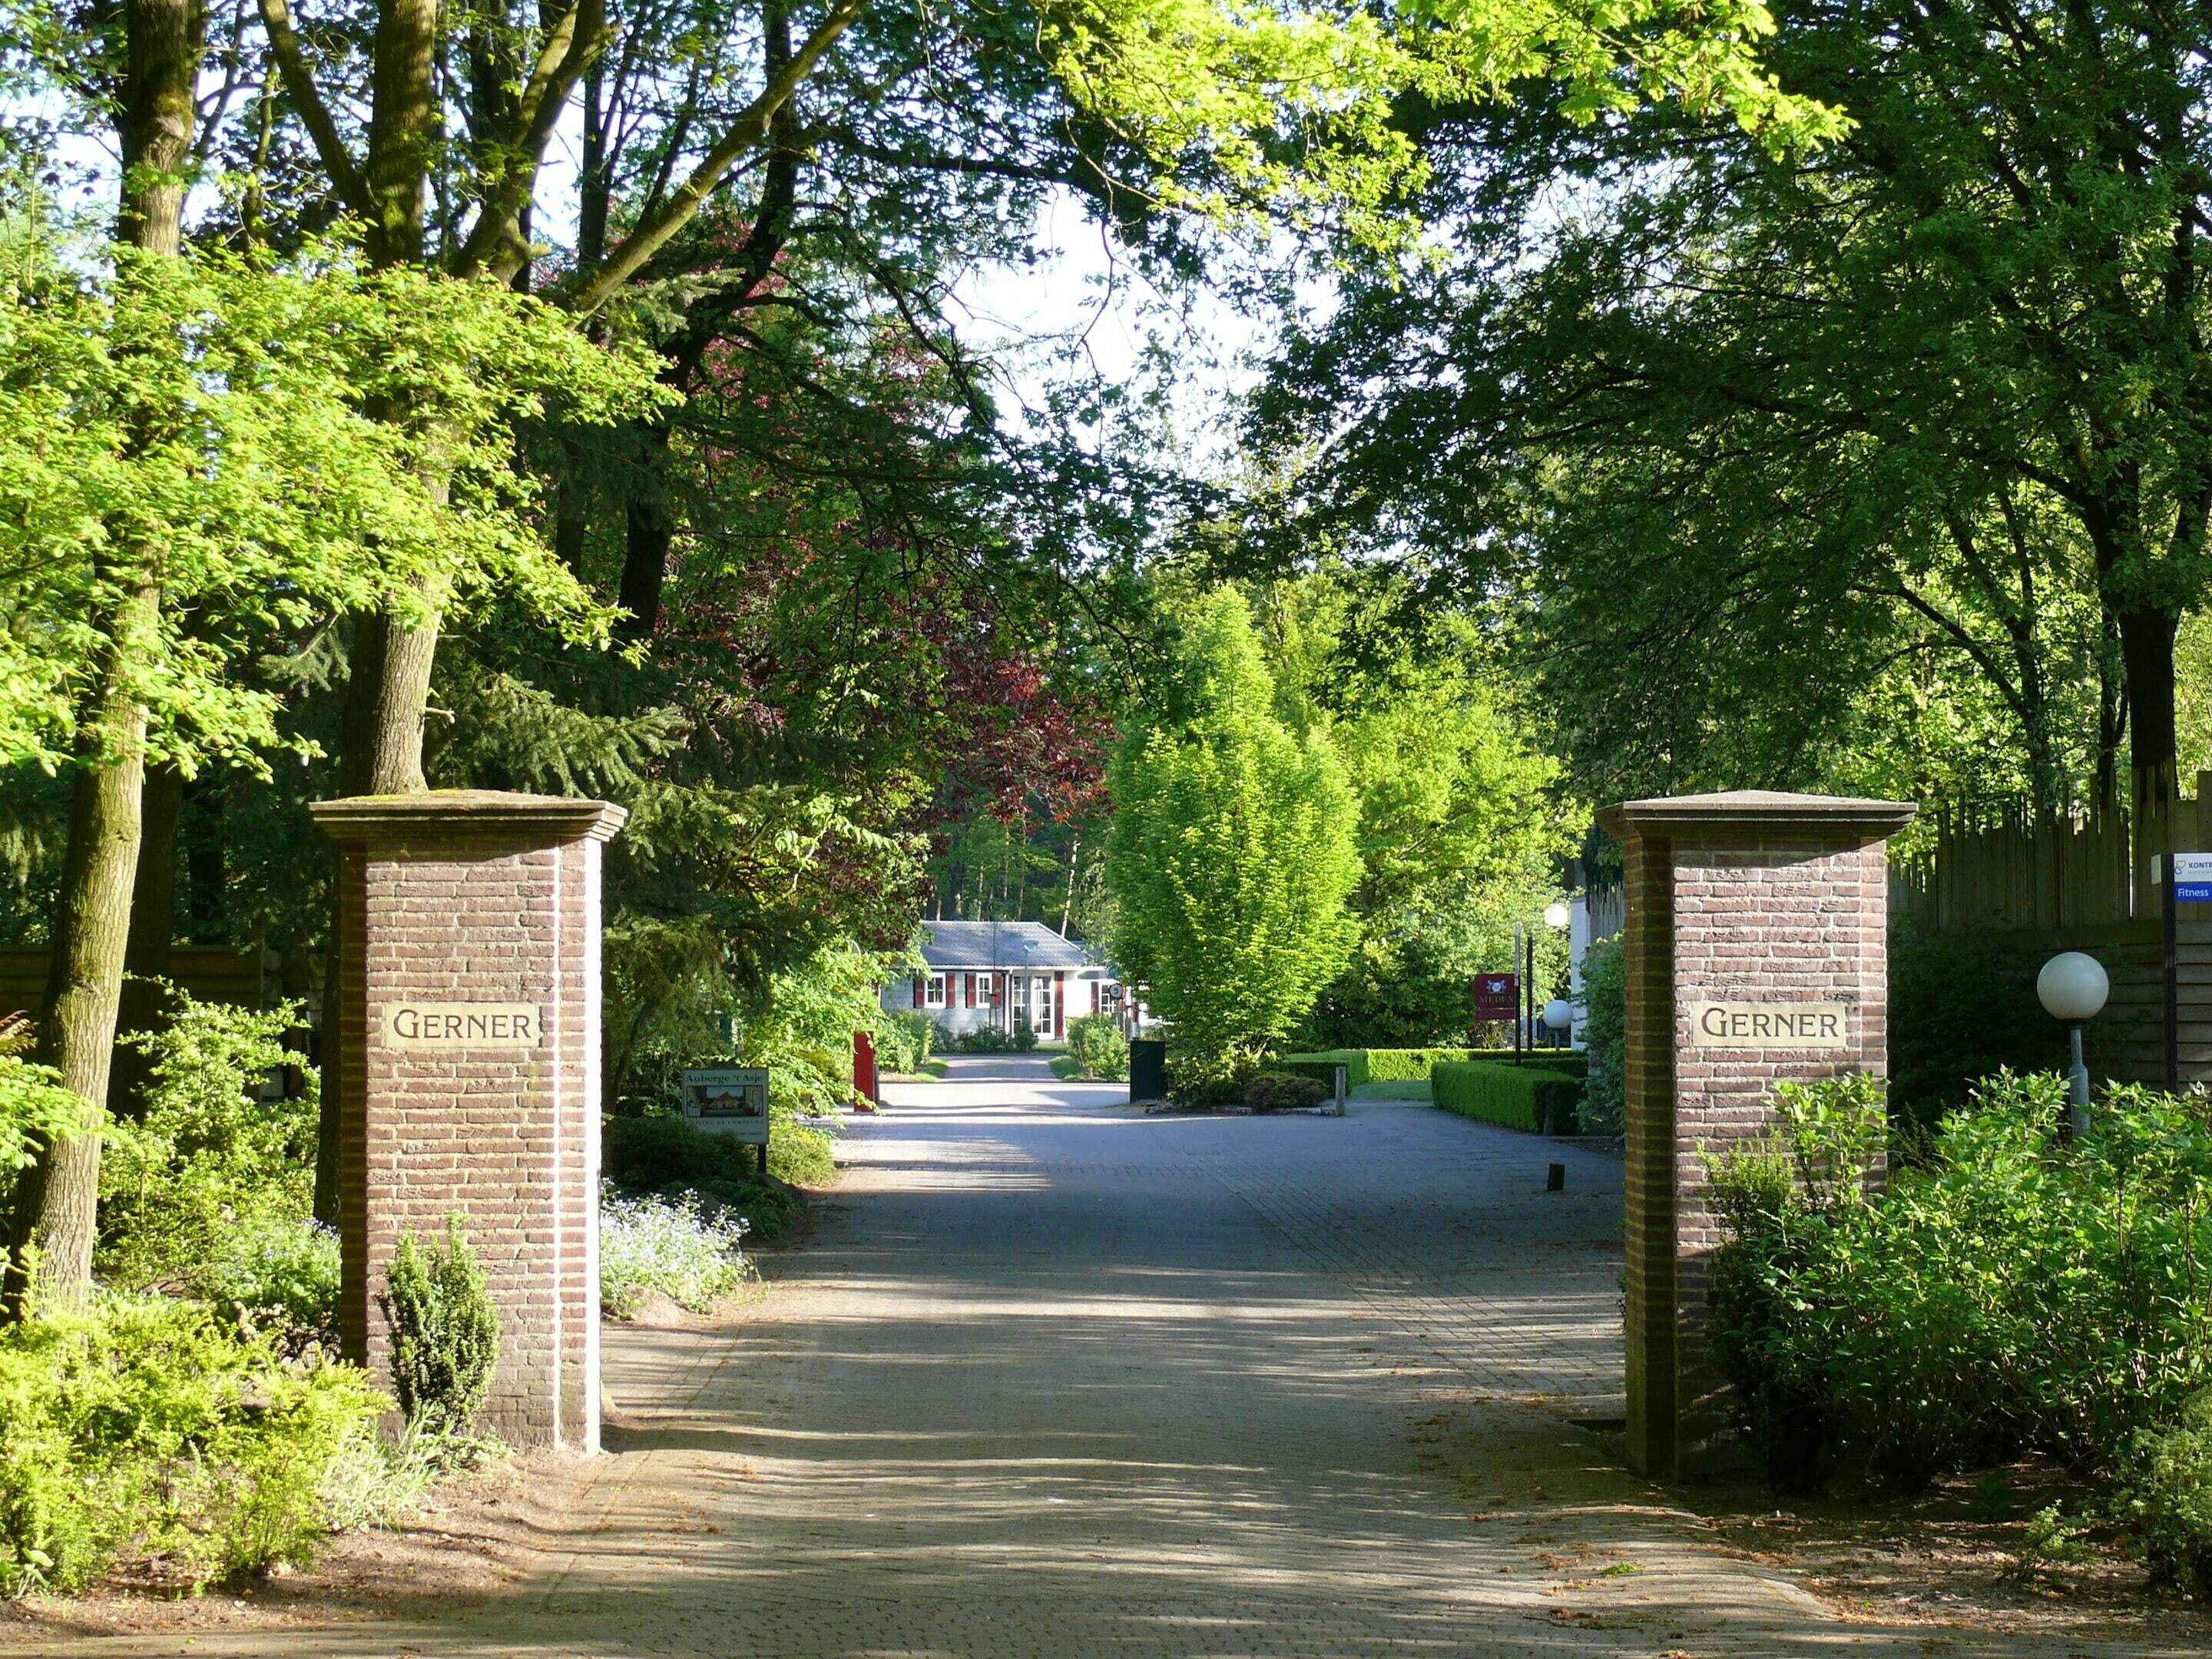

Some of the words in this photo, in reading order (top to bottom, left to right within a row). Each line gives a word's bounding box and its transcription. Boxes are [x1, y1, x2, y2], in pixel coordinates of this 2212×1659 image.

[2177, 887, 2209, 897] Fitness
[393, 1009, 531, 1038] GERNER
[1701, 1008, 1839, 1038] GERNER
[686, 1075, 730, 1084] Auberge
